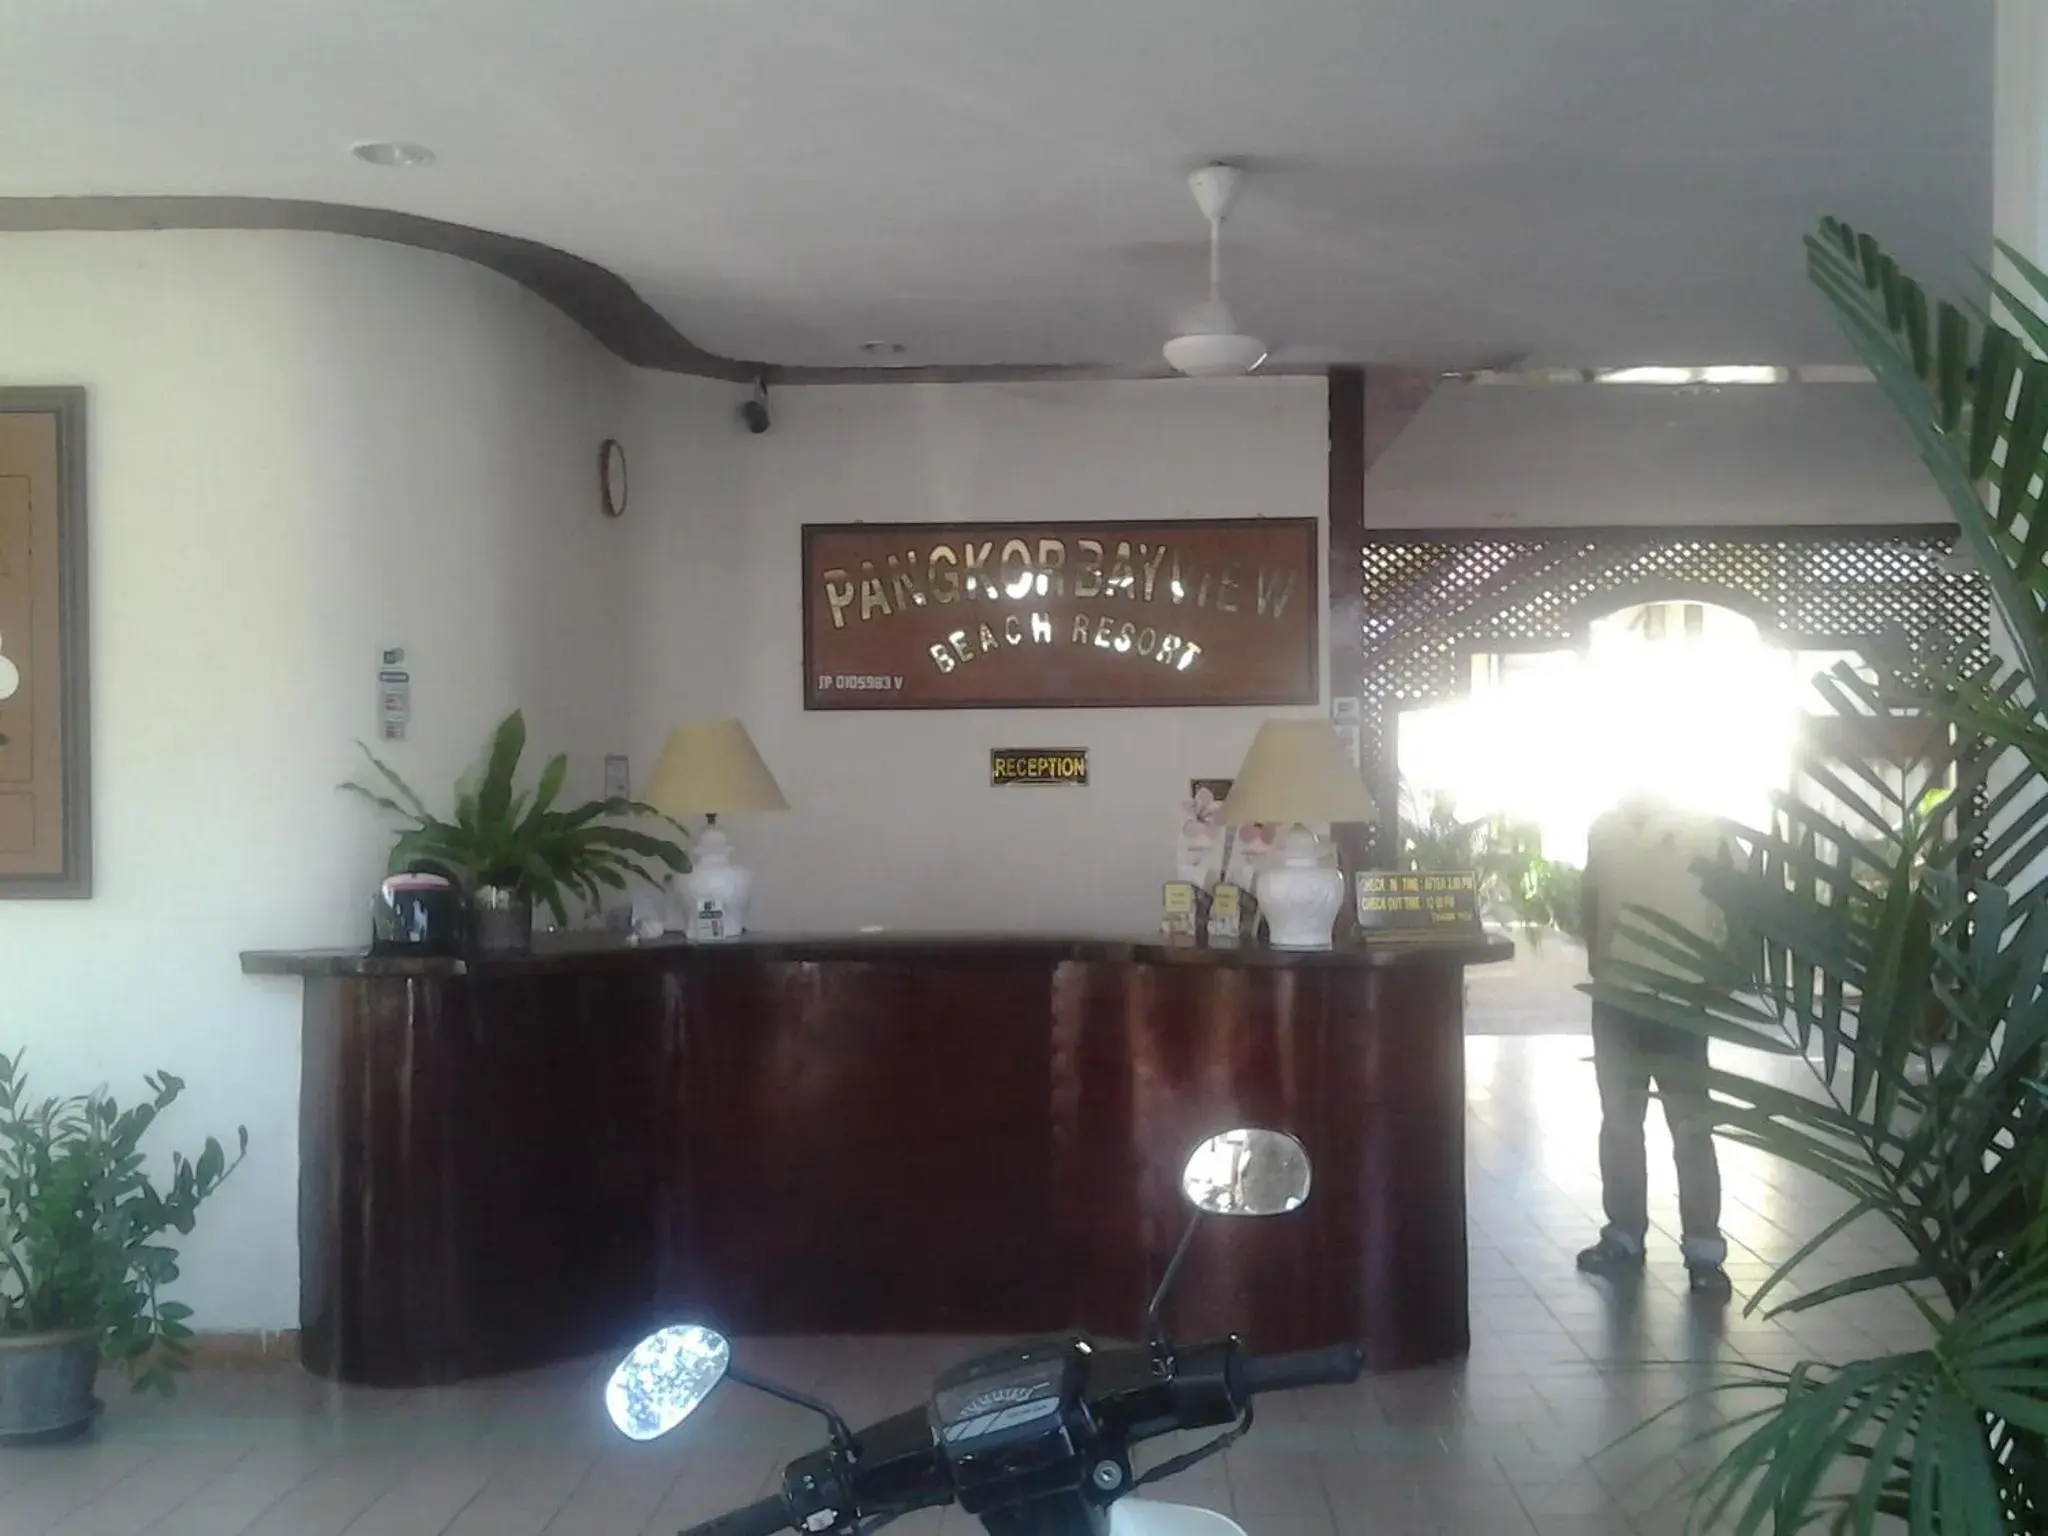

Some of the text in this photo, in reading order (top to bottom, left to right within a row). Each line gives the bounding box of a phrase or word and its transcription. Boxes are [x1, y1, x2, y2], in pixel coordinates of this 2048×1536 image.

[823, 538, 1067, 629] PANGKOR
[929, 612, 1202, 674] BEACH RESORT
[893, 674, 904, 690] V
[994, 756, 1085, 777] RECEPTION
[1360, 877, 1386, 892] CHECK
[1361, 896, 1386, 912] CHECK
